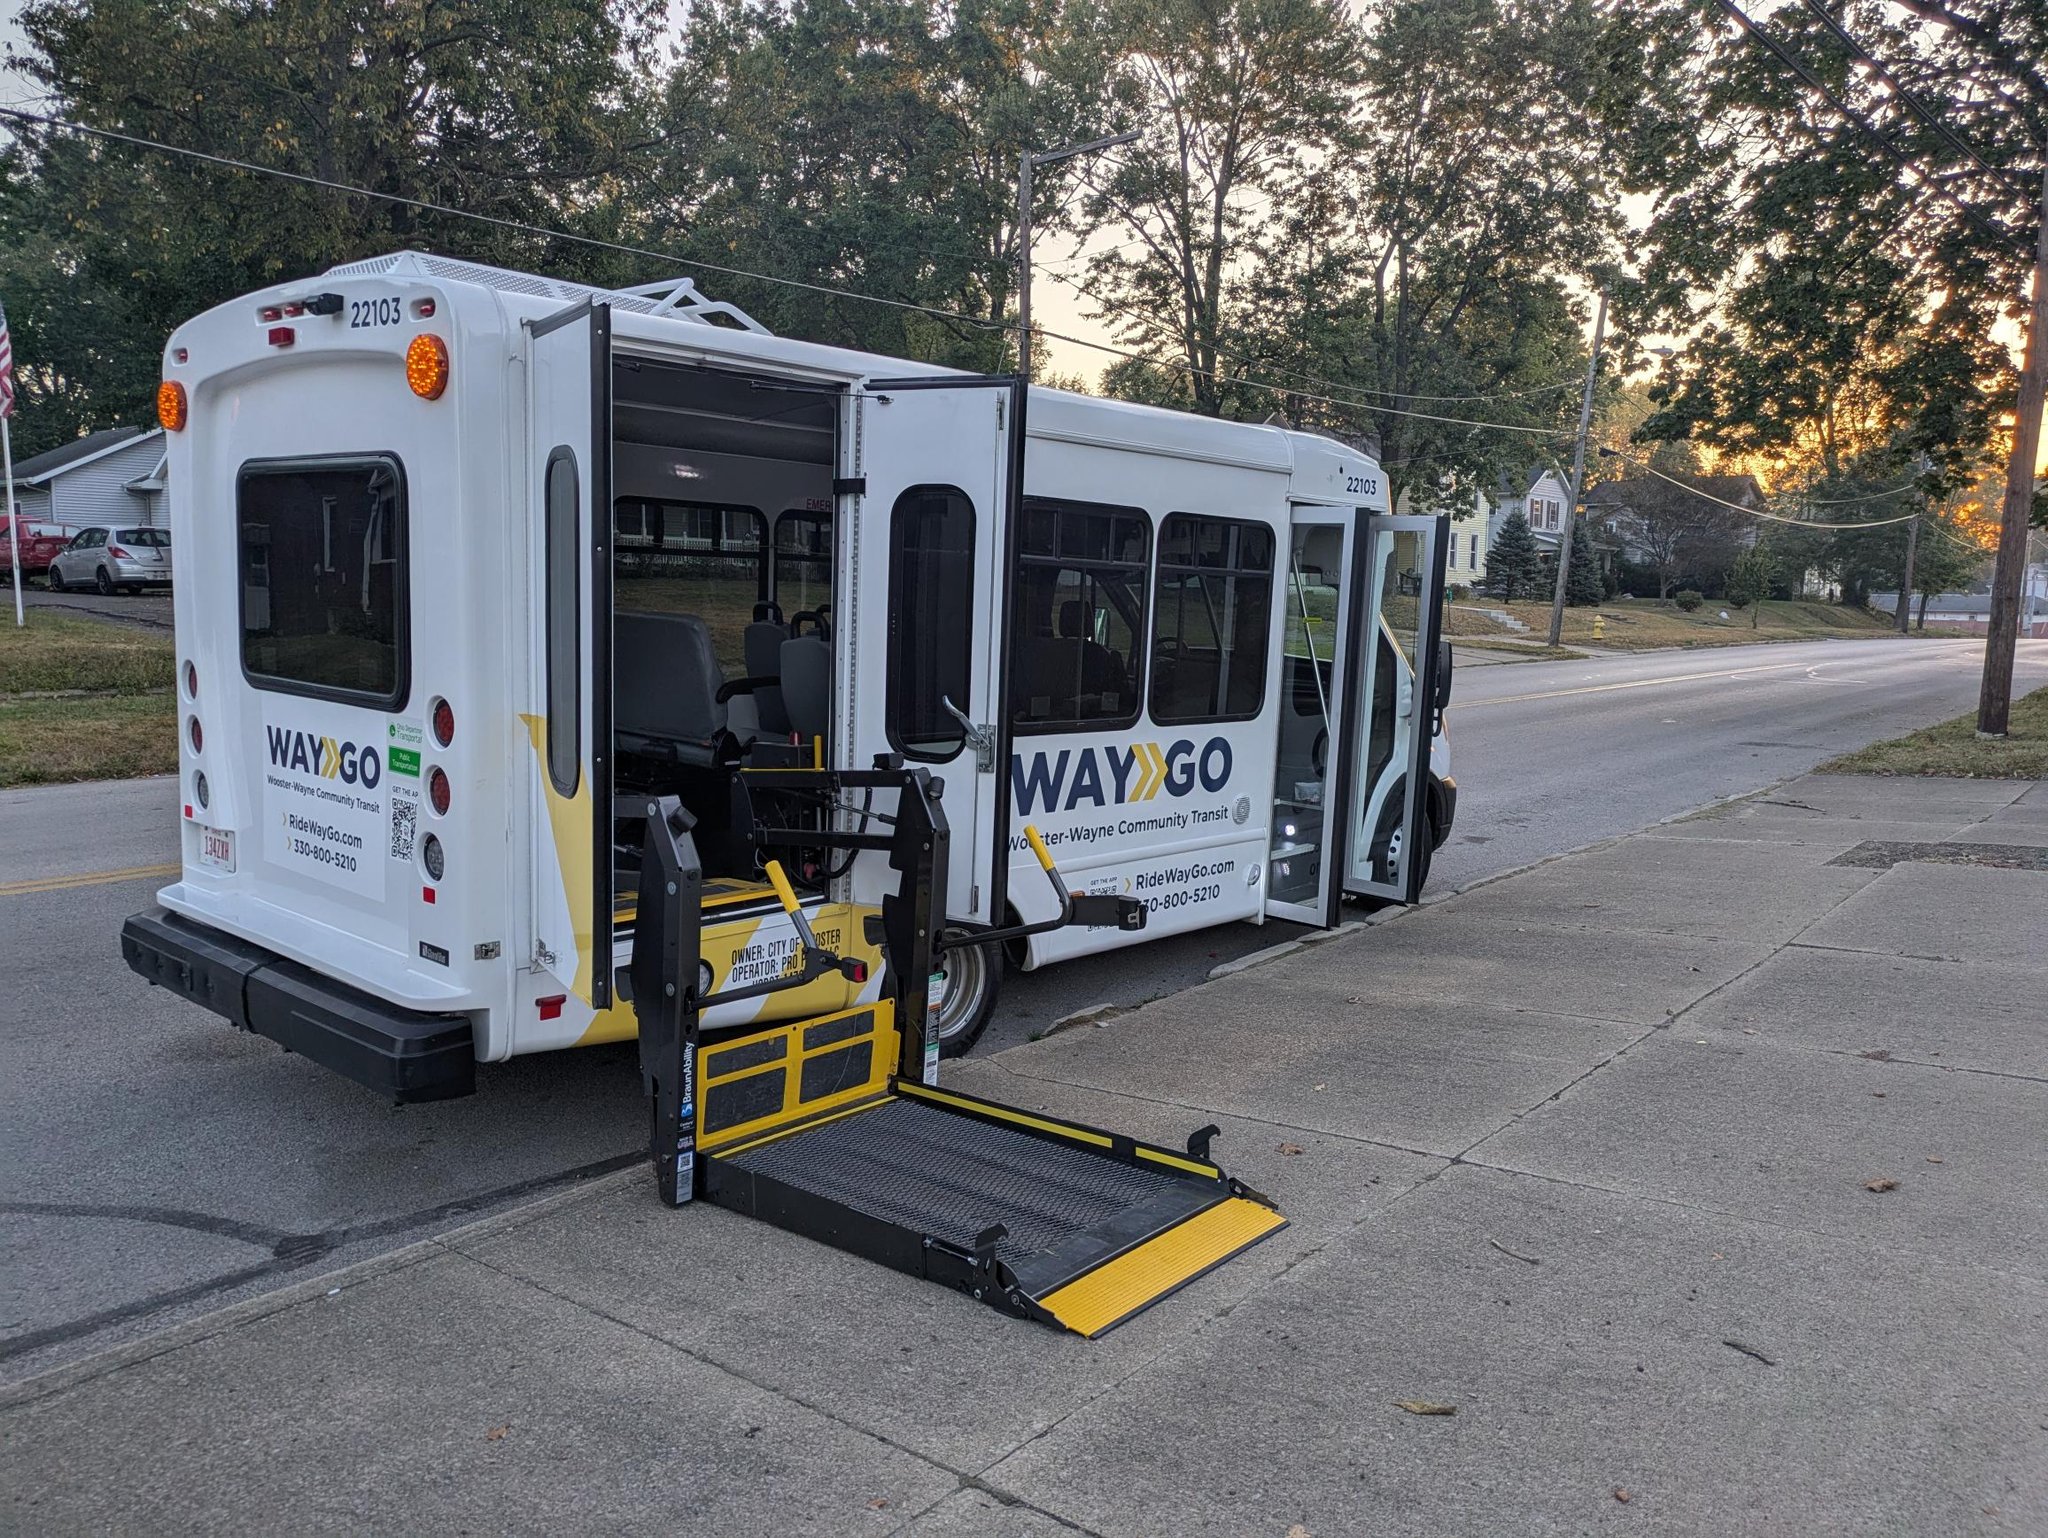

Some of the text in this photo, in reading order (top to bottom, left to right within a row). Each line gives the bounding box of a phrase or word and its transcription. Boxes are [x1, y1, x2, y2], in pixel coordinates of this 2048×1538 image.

[351, 298, 400, 328] 22103
[1346, 477, 1377, 495] 22103
[267, 774, 380, 814] Wooster-Wayne Community Transit
[392, 785, 401, 793] GET
[402, 788, 411, 796] THE
[289, 814, 363, 849] RideWayGo.com
[1009, 805, 1228, 851] Woter-Wayne Community Transit
[294, 839, 357, 872] 330-800-5210
[1136, 860, 1234, 890] RideWayGo.com
[1141, 884, 1220, 912] 30-800-5210
[731, 944, 765, 965] OWNER:
[768, 940, 787, 958] CITY
[790, 937, 800, 953] OF
[732, 959, 779, 983] OPERATOR:
[781, 954, 798, 972] PRO
[683, 1041, 695, 1104] BraunAbility
